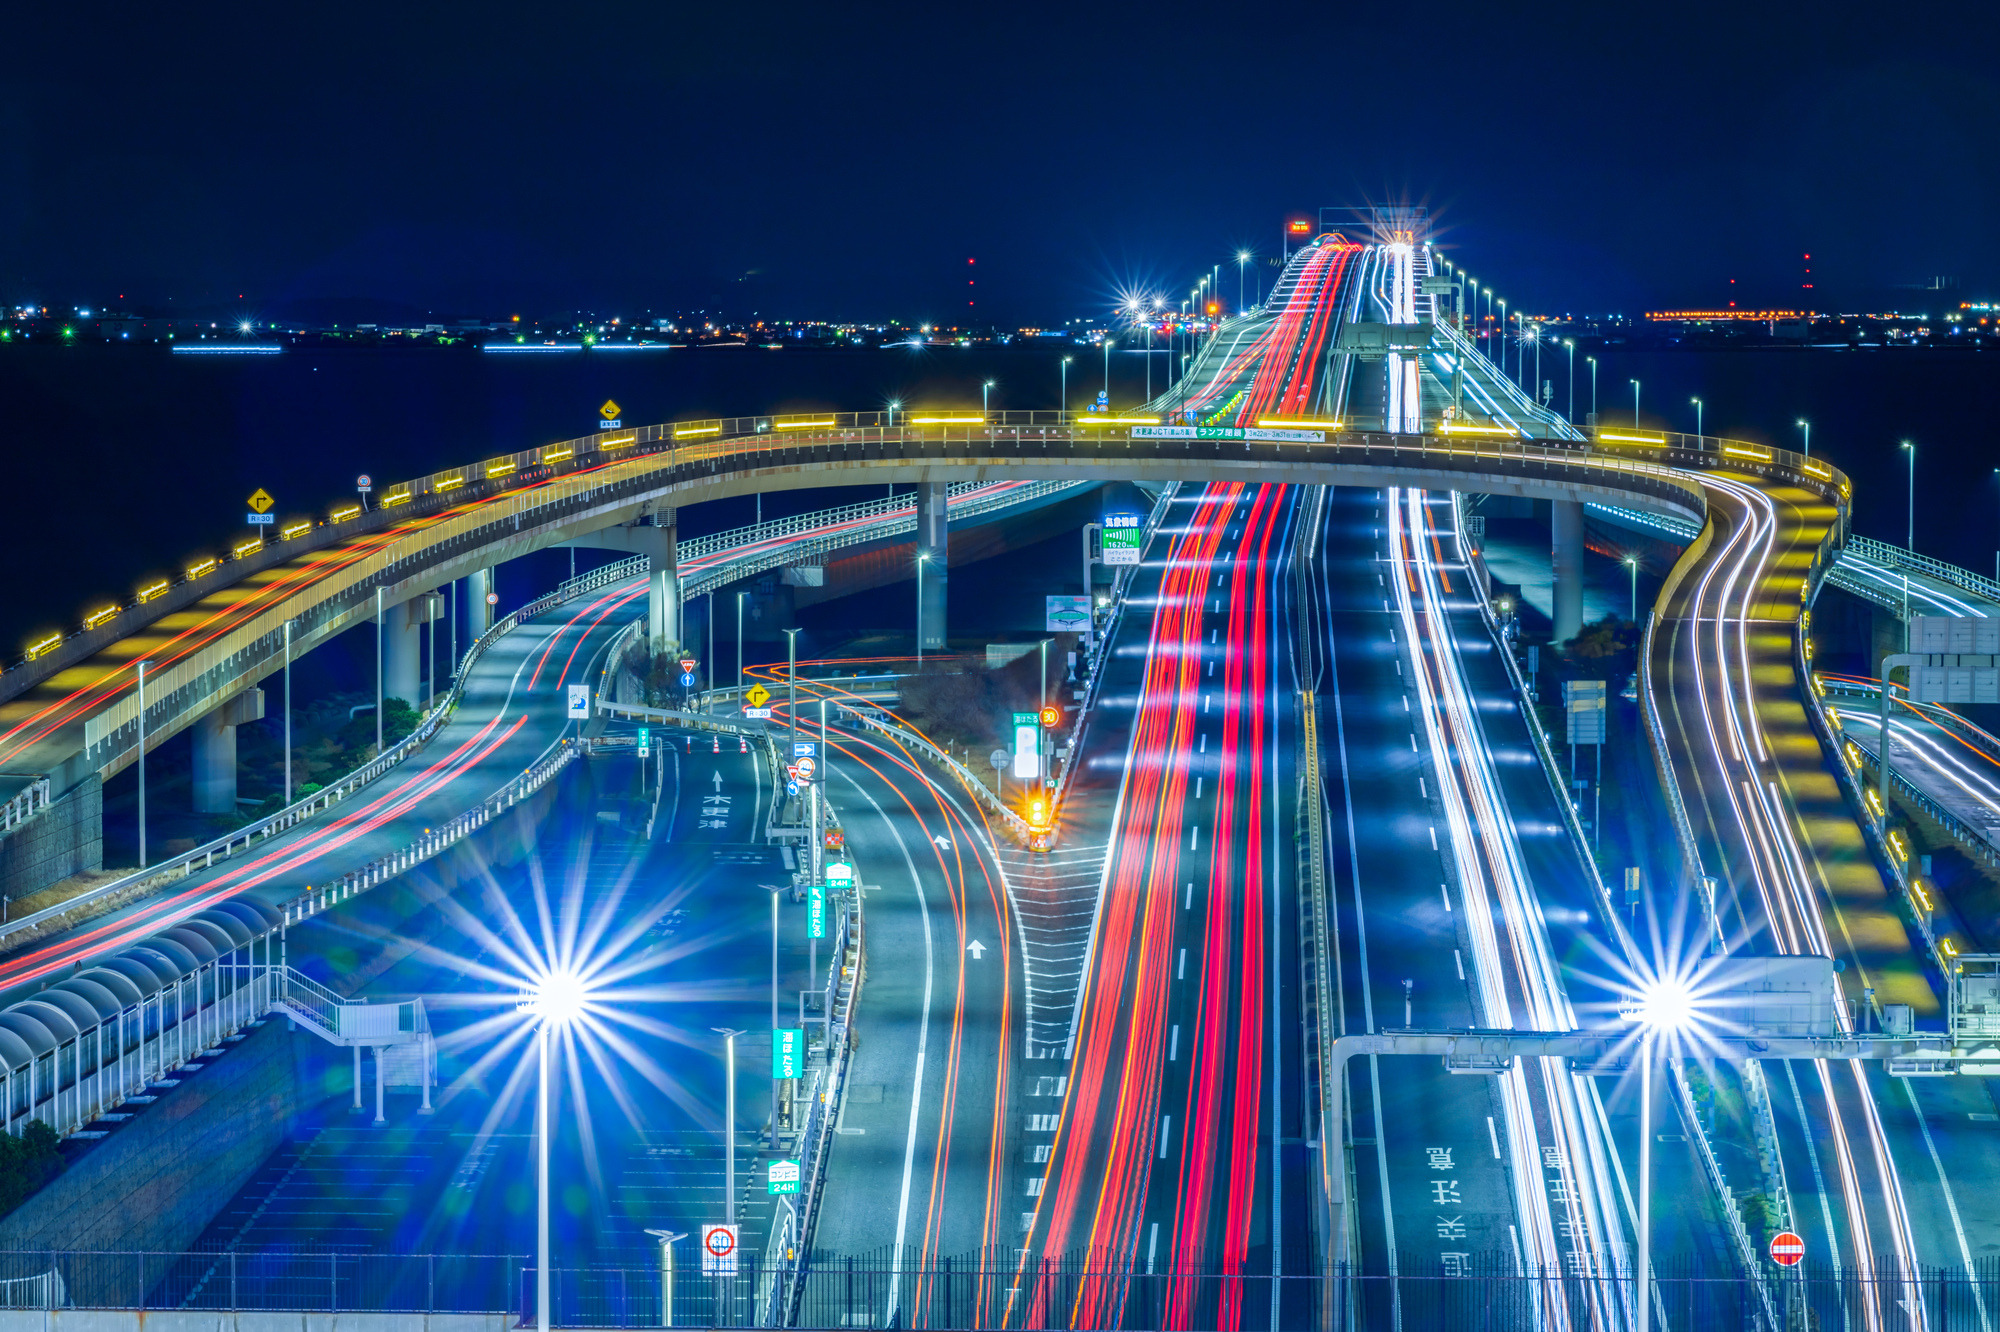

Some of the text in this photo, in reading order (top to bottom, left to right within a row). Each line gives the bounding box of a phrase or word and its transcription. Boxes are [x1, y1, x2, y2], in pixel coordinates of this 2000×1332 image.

[1043, 712, 1055, 722] 30
[812, 900, 821, 937] 海ほたる
[782, 1031, 794, 1078] 海ほたる
[771, 1170, 797, 1179] コンビニ
[773, 1183, 795, 1192] 24H
